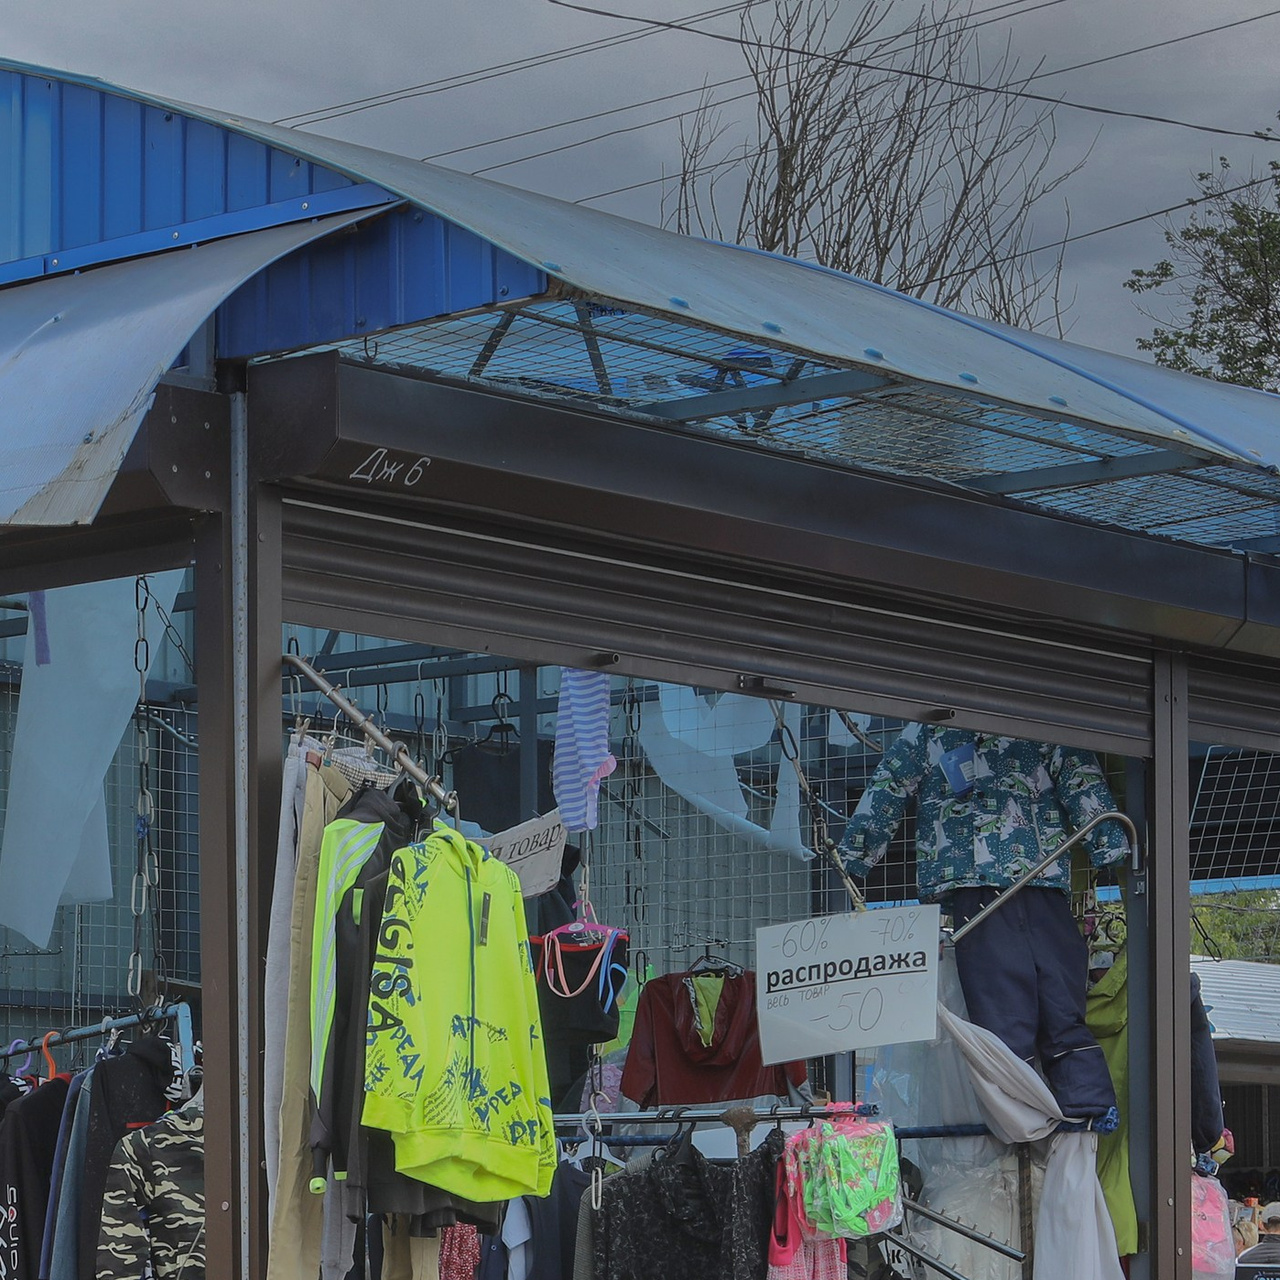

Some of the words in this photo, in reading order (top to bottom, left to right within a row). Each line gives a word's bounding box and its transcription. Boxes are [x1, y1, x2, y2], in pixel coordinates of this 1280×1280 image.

[771, 917, 833, 958] -60%
[766, 950, 928, 995] распродажа
[810, 986, 884, 1032] -50
[6, 1184, 19, 1271] SQUID
